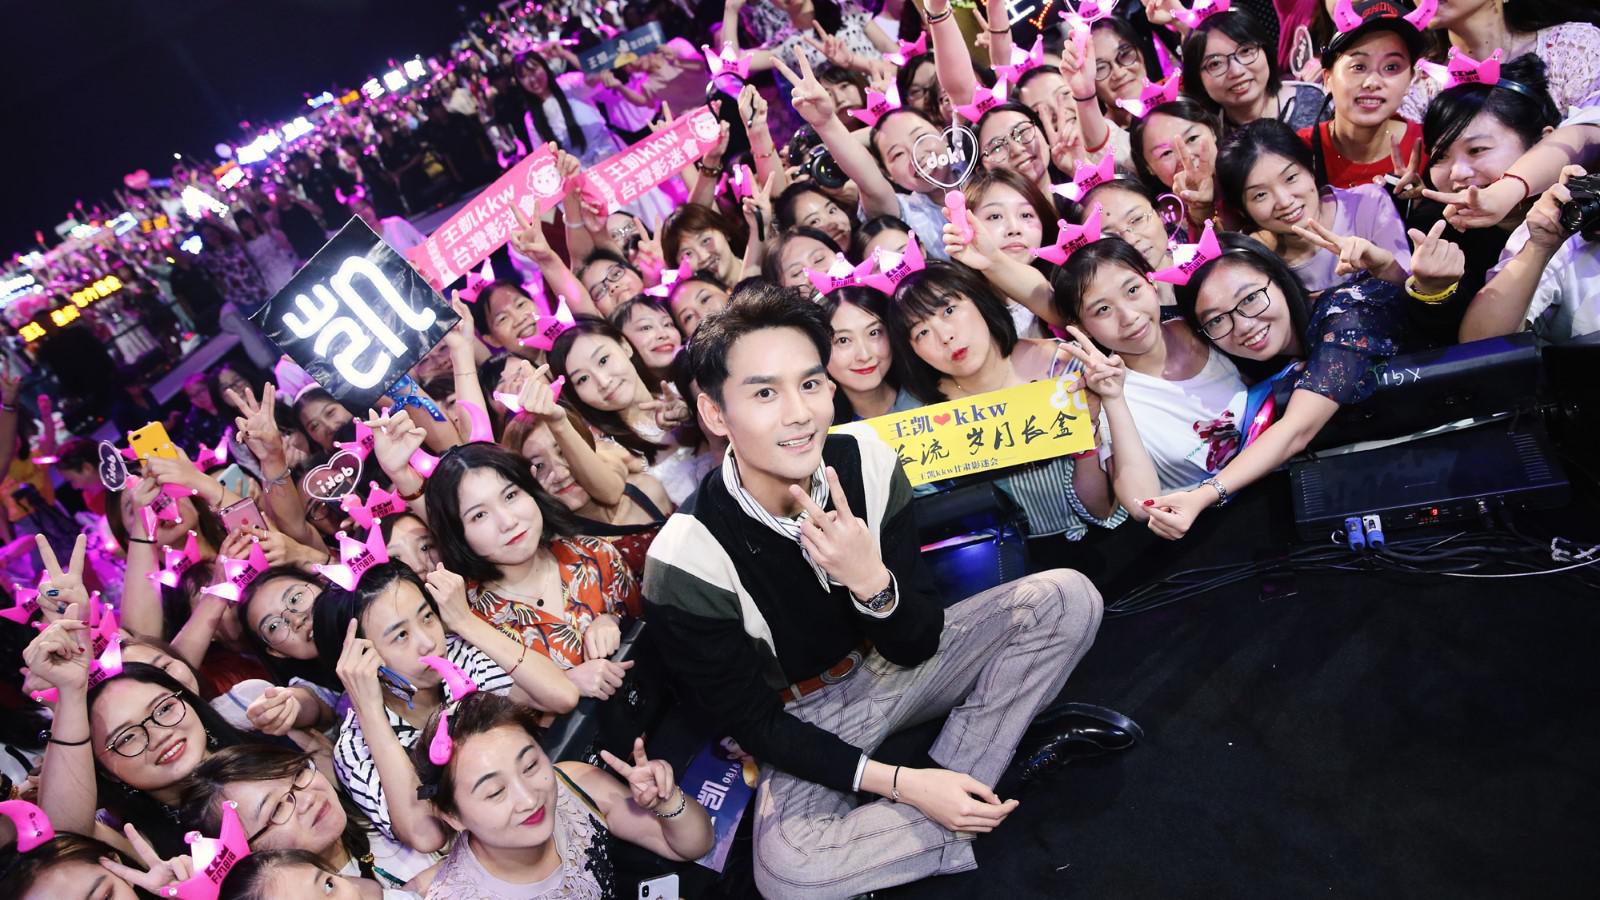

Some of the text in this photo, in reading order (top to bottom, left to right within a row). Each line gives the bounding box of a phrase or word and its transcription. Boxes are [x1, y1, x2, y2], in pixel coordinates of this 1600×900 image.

[926, 141, 966, 169] doki
[888, 402, 1008, 441] 王凯 kkw
[204, 844, 229, 877] KKW
[211, 851, 237, 885] FM818
